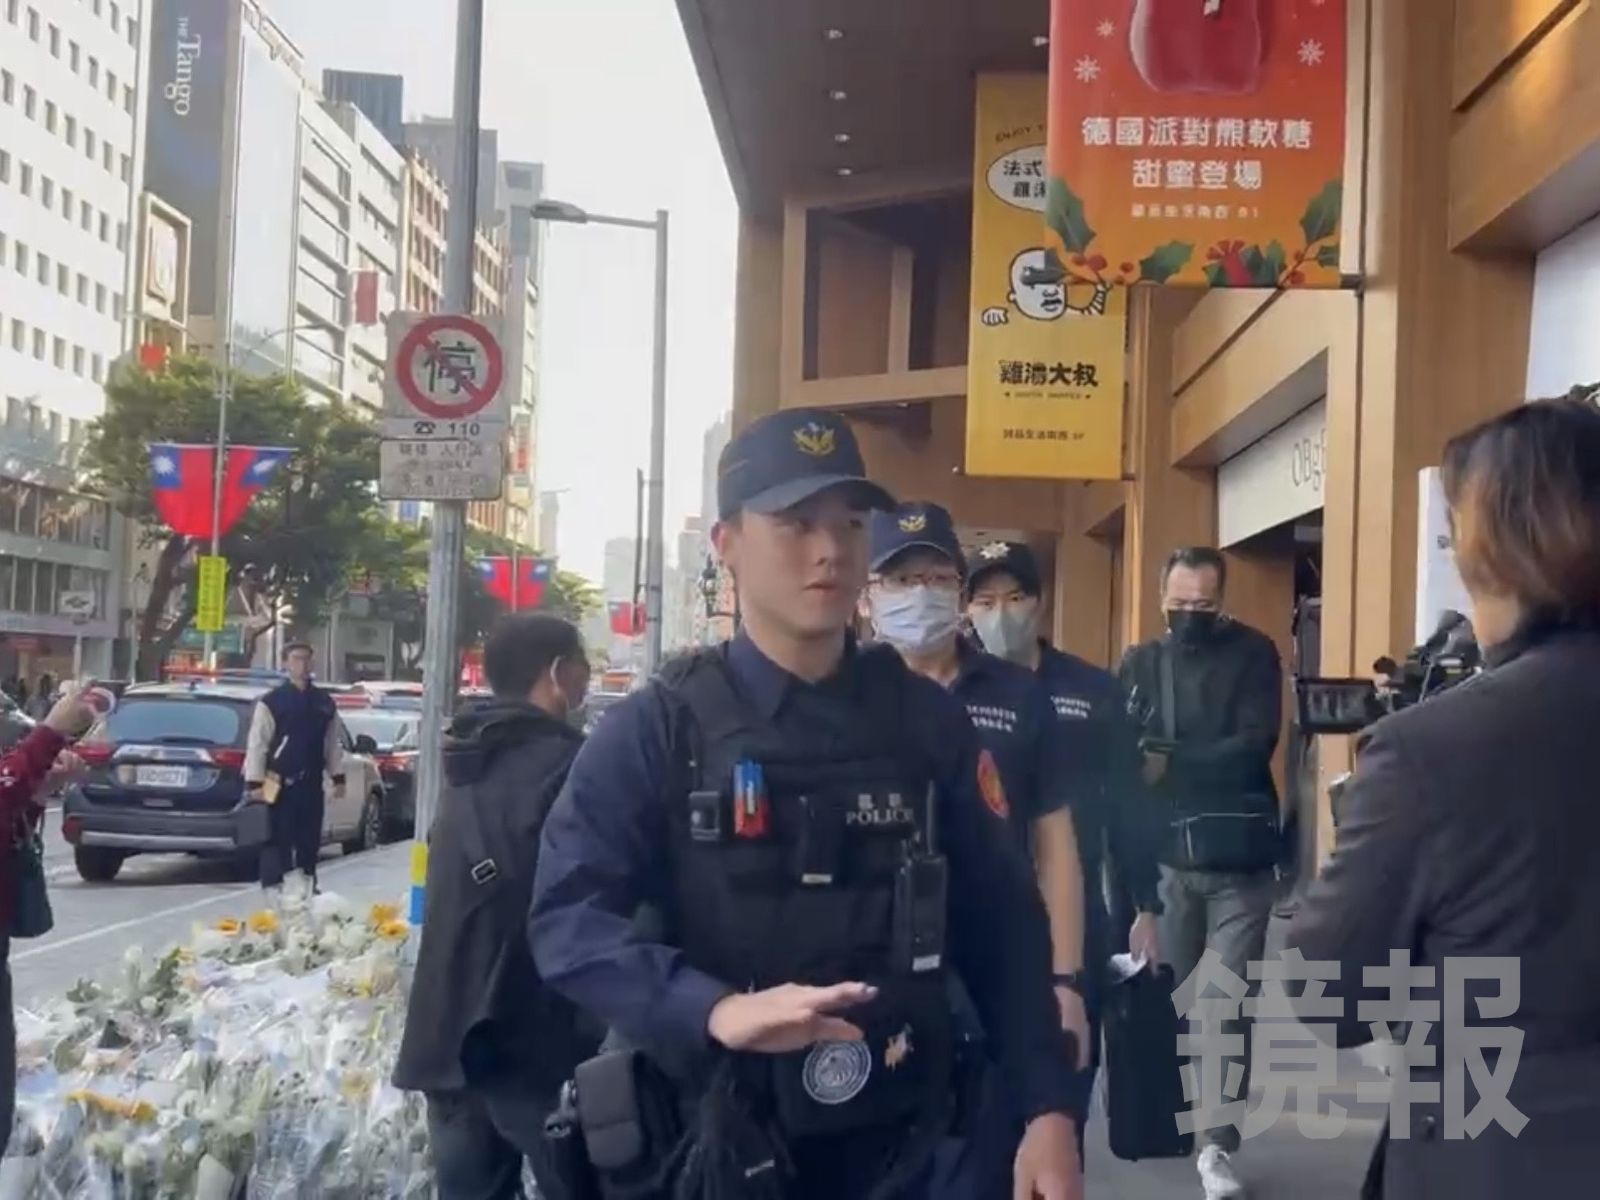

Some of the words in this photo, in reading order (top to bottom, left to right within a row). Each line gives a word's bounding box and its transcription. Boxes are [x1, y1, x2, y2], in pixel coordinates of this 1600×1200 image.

[177, 16, 189, 38] THE
[164, 34, 201, 115] Tango
[1082, 117, 1312, 149] 德國派對熊軟糖
[1132, 159, 1263, 190] 甜蜜登場
[423, 341, 476, 394] 停
[450, 422, 480, 436] 110
